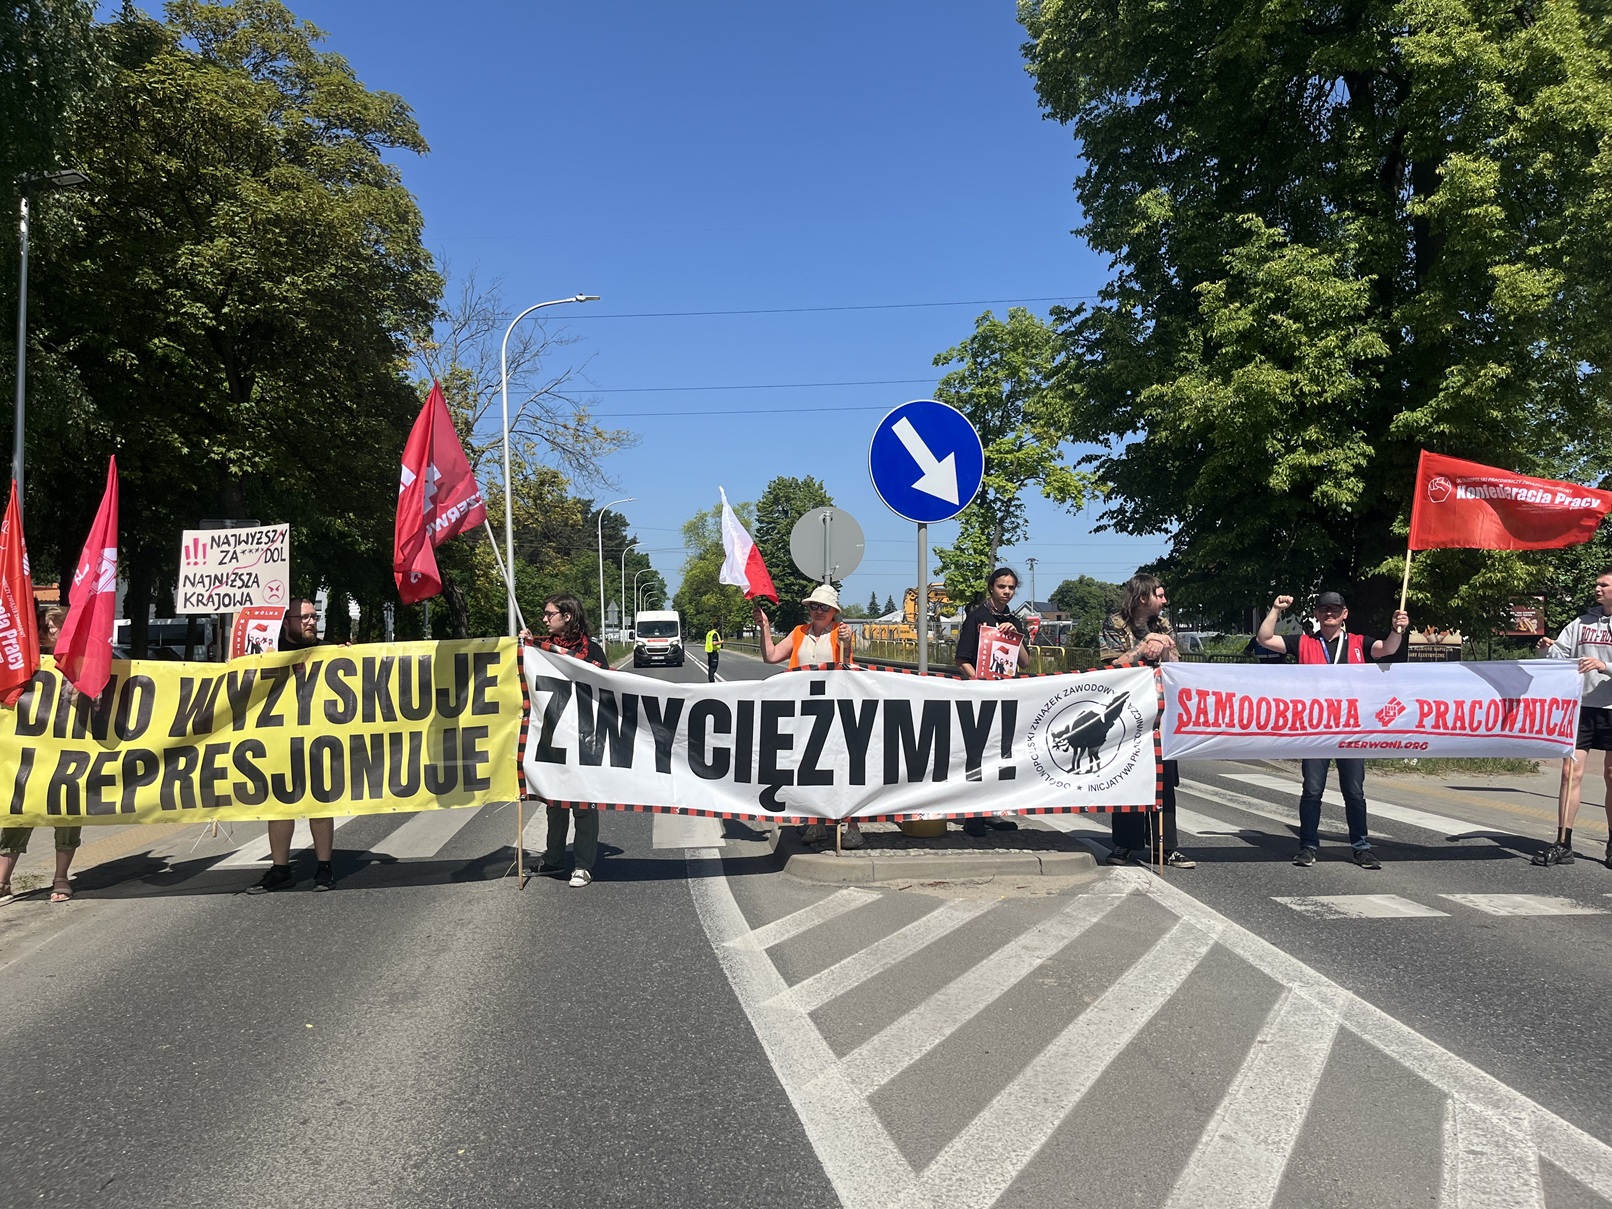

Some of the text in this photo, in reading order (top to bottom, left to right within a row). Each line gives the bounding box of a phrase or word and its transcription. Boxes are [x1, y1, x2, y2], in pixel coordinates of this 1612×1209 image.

[1554, 492, 1602, 509] Pracy
[183, 591, 253, 611] KRAJOWA
[0, 628, 25, 671] Pracy
[236, 619, 246, 656] MŁODZI
[15, 652, 501, 741] DINO WYZYSKUJE
[1030, 693, 1063, 731] ZWIĄZEK
[1174, 688, 1579, 739] SAMOOBRONA PRACOWNICZA
[535, 674, 1019, 813] ZWYCIĘŻYMY!
[1337, 740, 1430, 750] CZERWONI.ORG
[9, 725, 492, 816] I REPRESJONUJE
[1087, 763, 1136, 793] INICJATYWA
